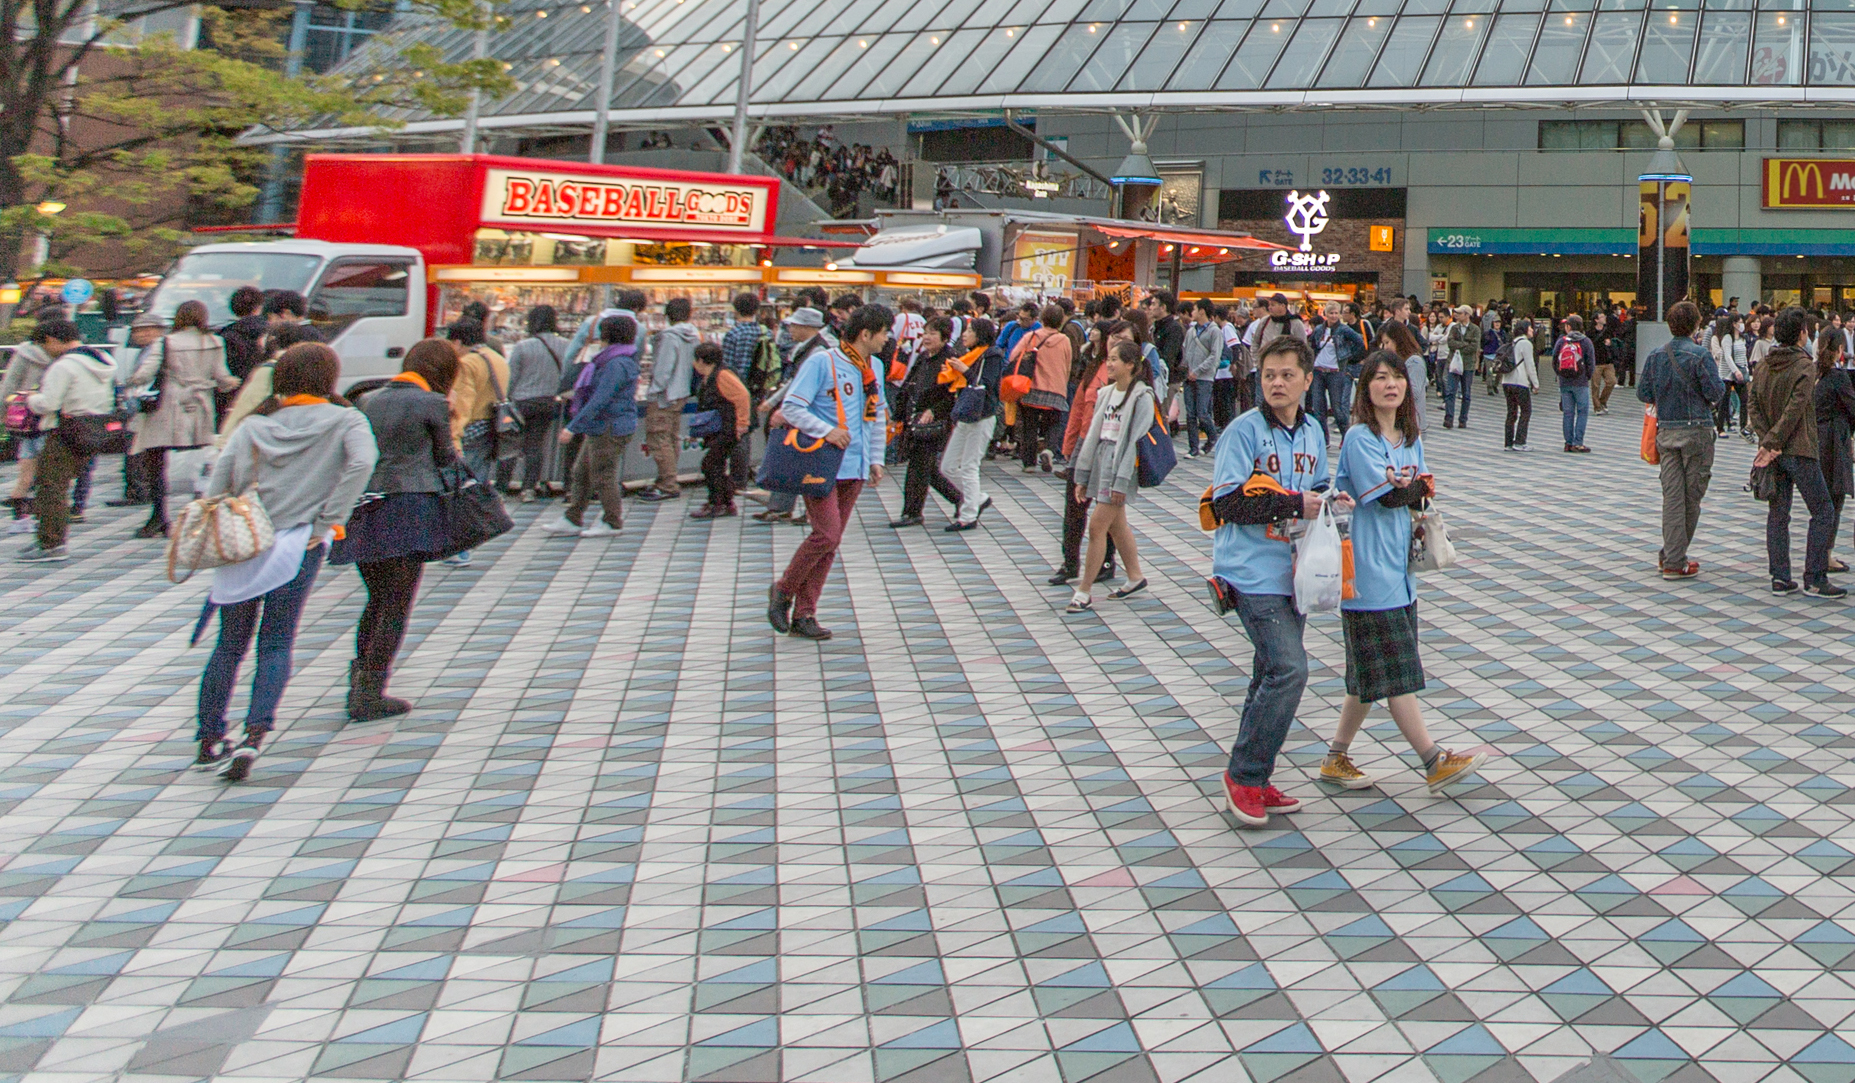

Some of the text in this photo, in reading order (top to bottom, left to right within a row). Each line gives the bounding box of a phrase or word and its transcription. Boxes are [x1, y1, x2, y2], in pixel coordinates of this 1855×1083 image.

[1274, 177, 1293, 186] GATE
[503, 178, 683, 221] BASEBALL
[1447, 235, 1465, 249] 23
